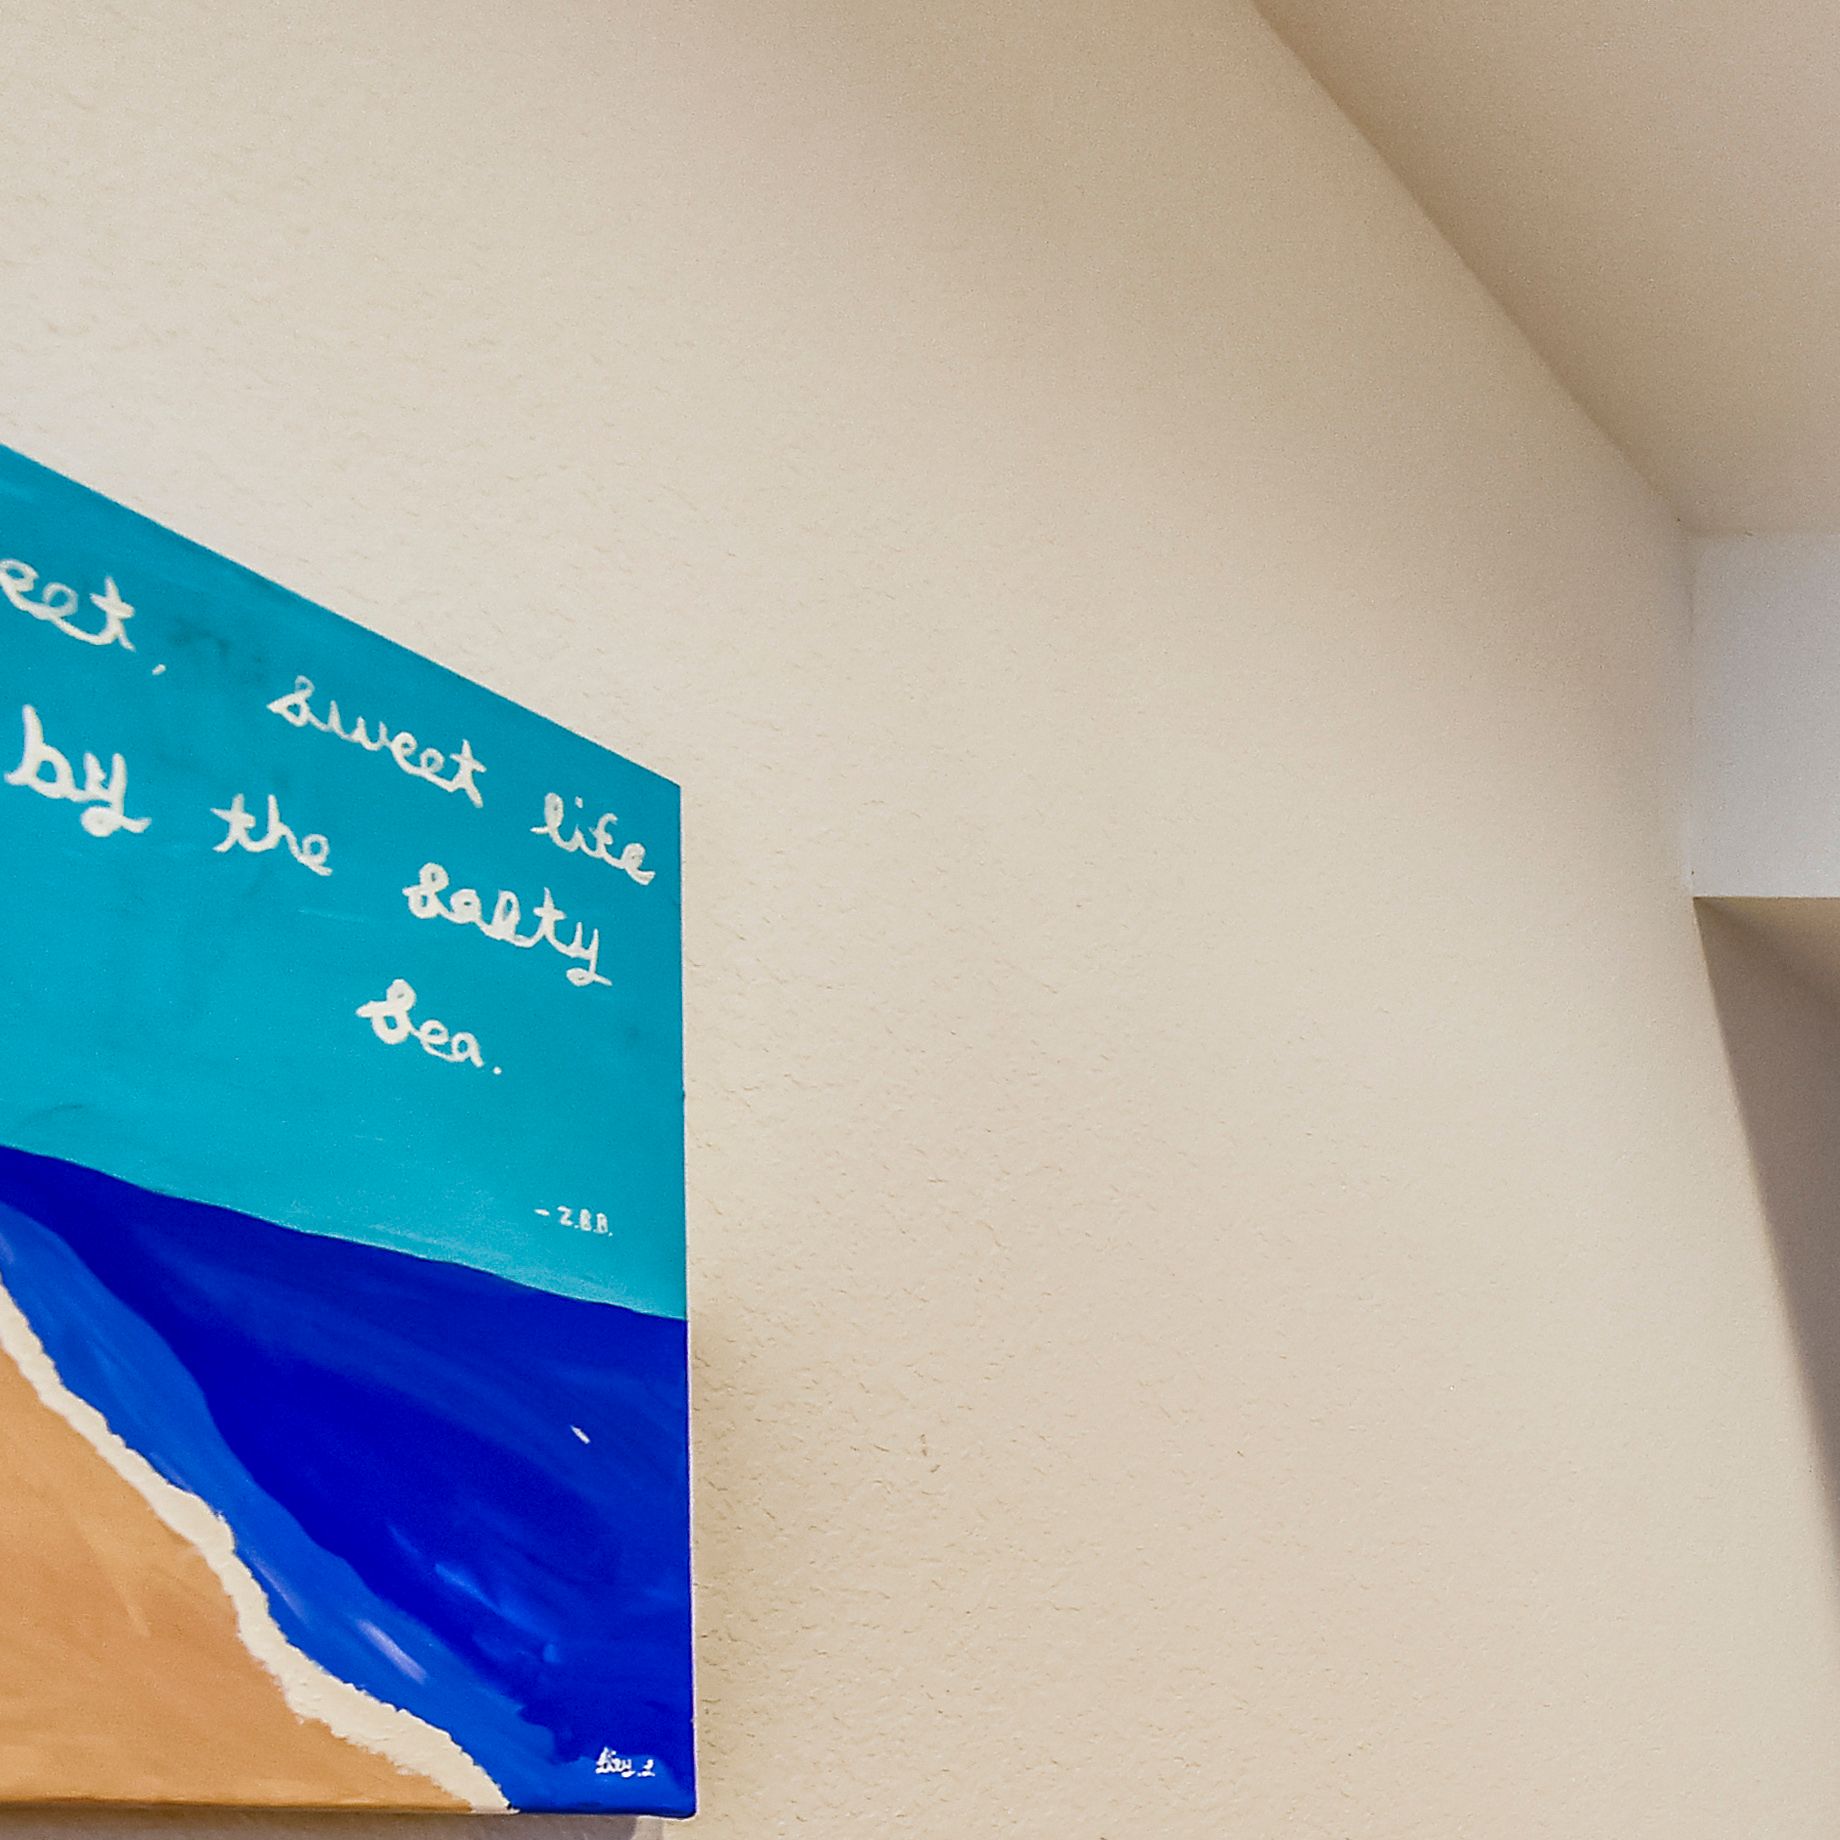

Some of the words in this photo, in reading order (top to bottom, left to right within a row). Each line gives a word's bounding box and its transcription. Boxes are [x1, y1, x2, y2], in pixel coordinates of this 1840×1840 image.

[5, 705, 150, 837] by
[212, 795, 332, 876] the
[404, 863, 612, 987] salty
[268, 676, 487, 809] sweet
[531, 793, 656, 886] life
[356, 979, 502, 1075] sea.
